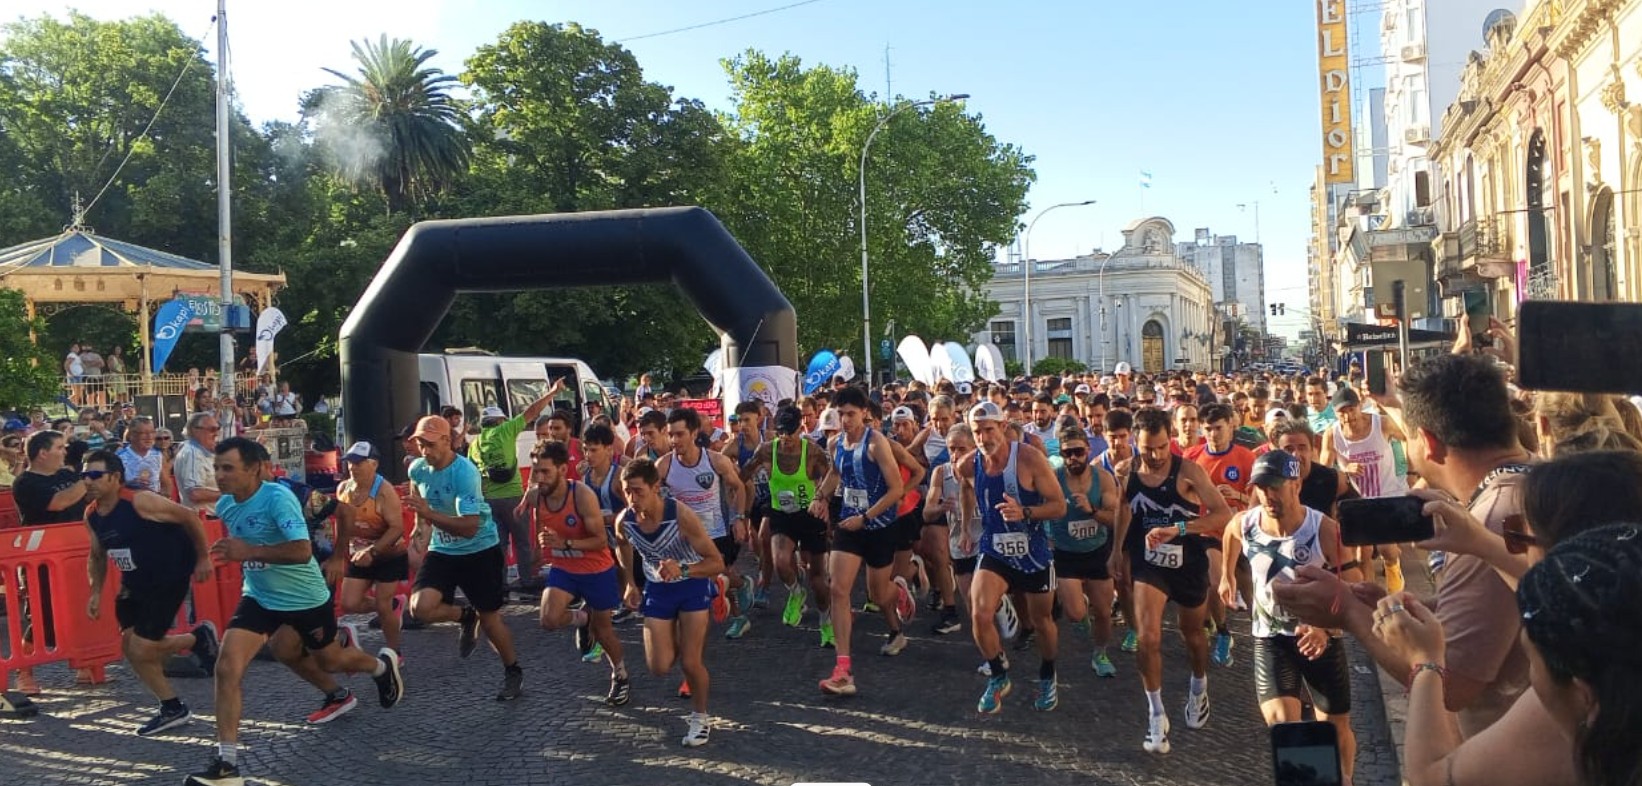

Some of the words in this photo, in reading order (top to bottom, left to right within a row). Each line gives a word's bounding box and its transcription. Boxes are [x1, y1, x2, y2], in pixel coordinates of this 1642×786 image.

[155, 303, 192, 339] Okapi
[852, 495, 859, 508] 9
[995, 540, 1026, 556] 356
[1148, 550, 1178, 568] 278
